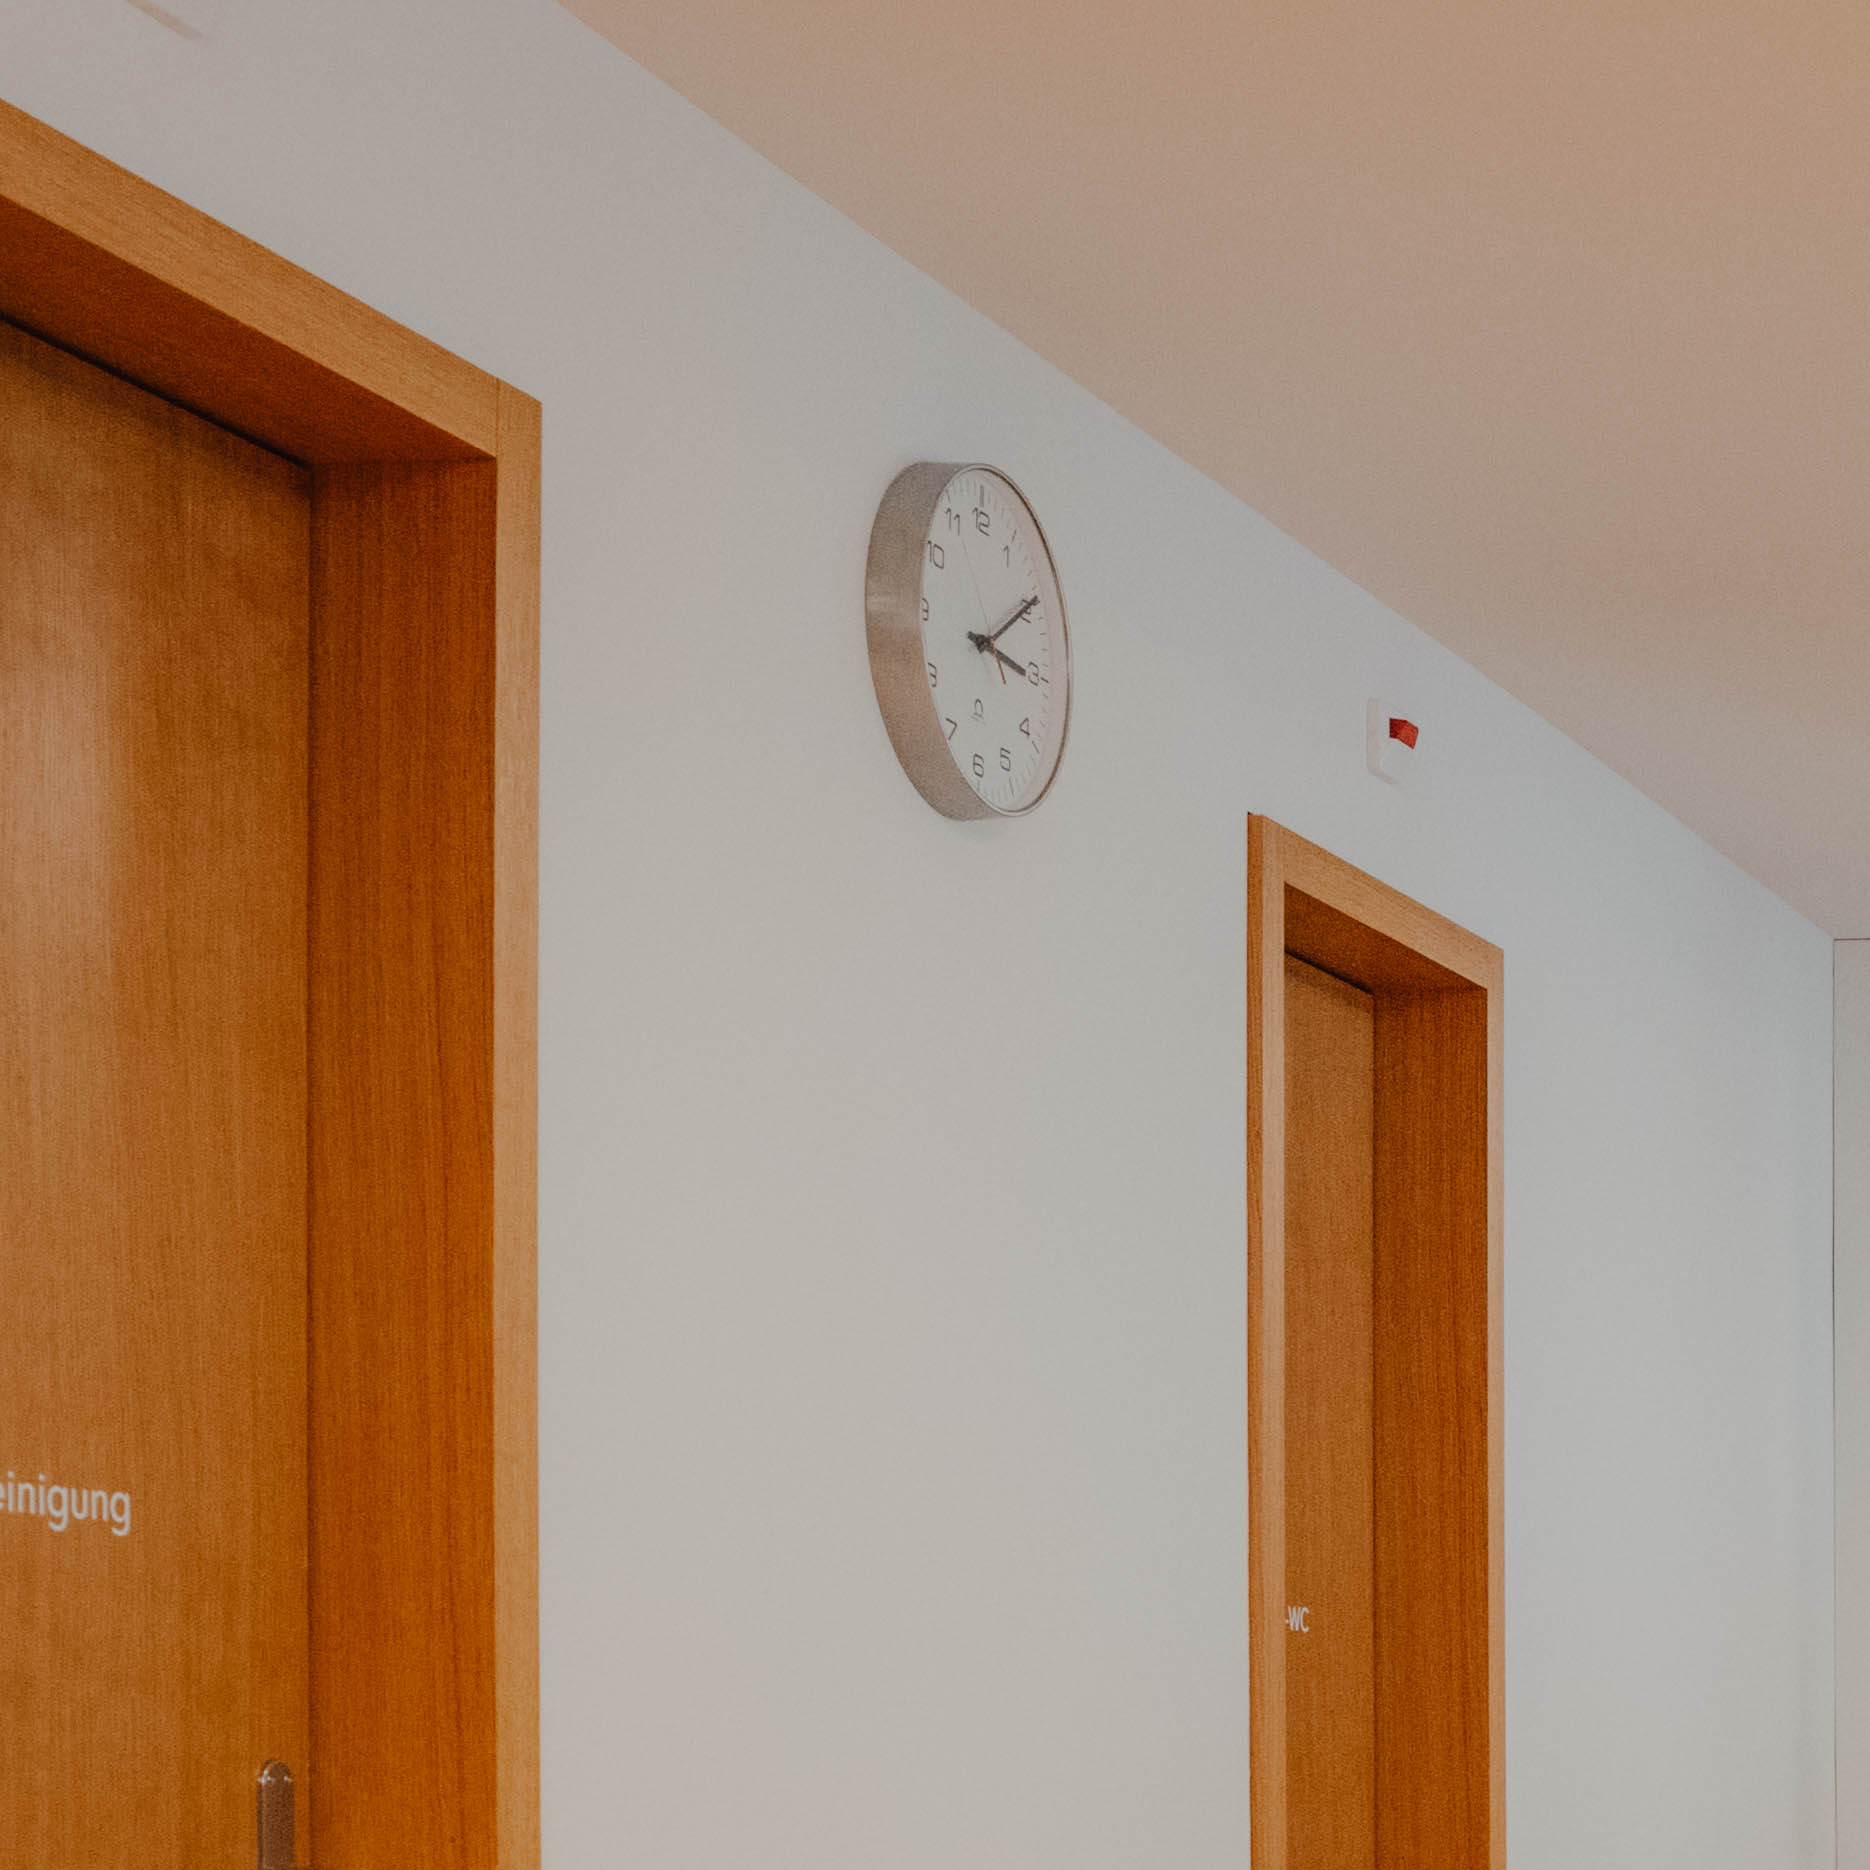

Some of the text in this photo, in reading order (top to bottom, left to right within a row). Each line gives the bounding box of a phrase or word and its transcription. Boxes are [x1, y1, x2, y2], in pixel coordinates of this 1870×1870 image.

[945, 507, 960, 536] 11
[971, 507, 991, 537] 12
[1003, 545, 1010, 569] 1
[945, 717, 958, 741] 7
[1019, 717, 1031, 740] 4
[1000, 747, 1012, 772] 5
